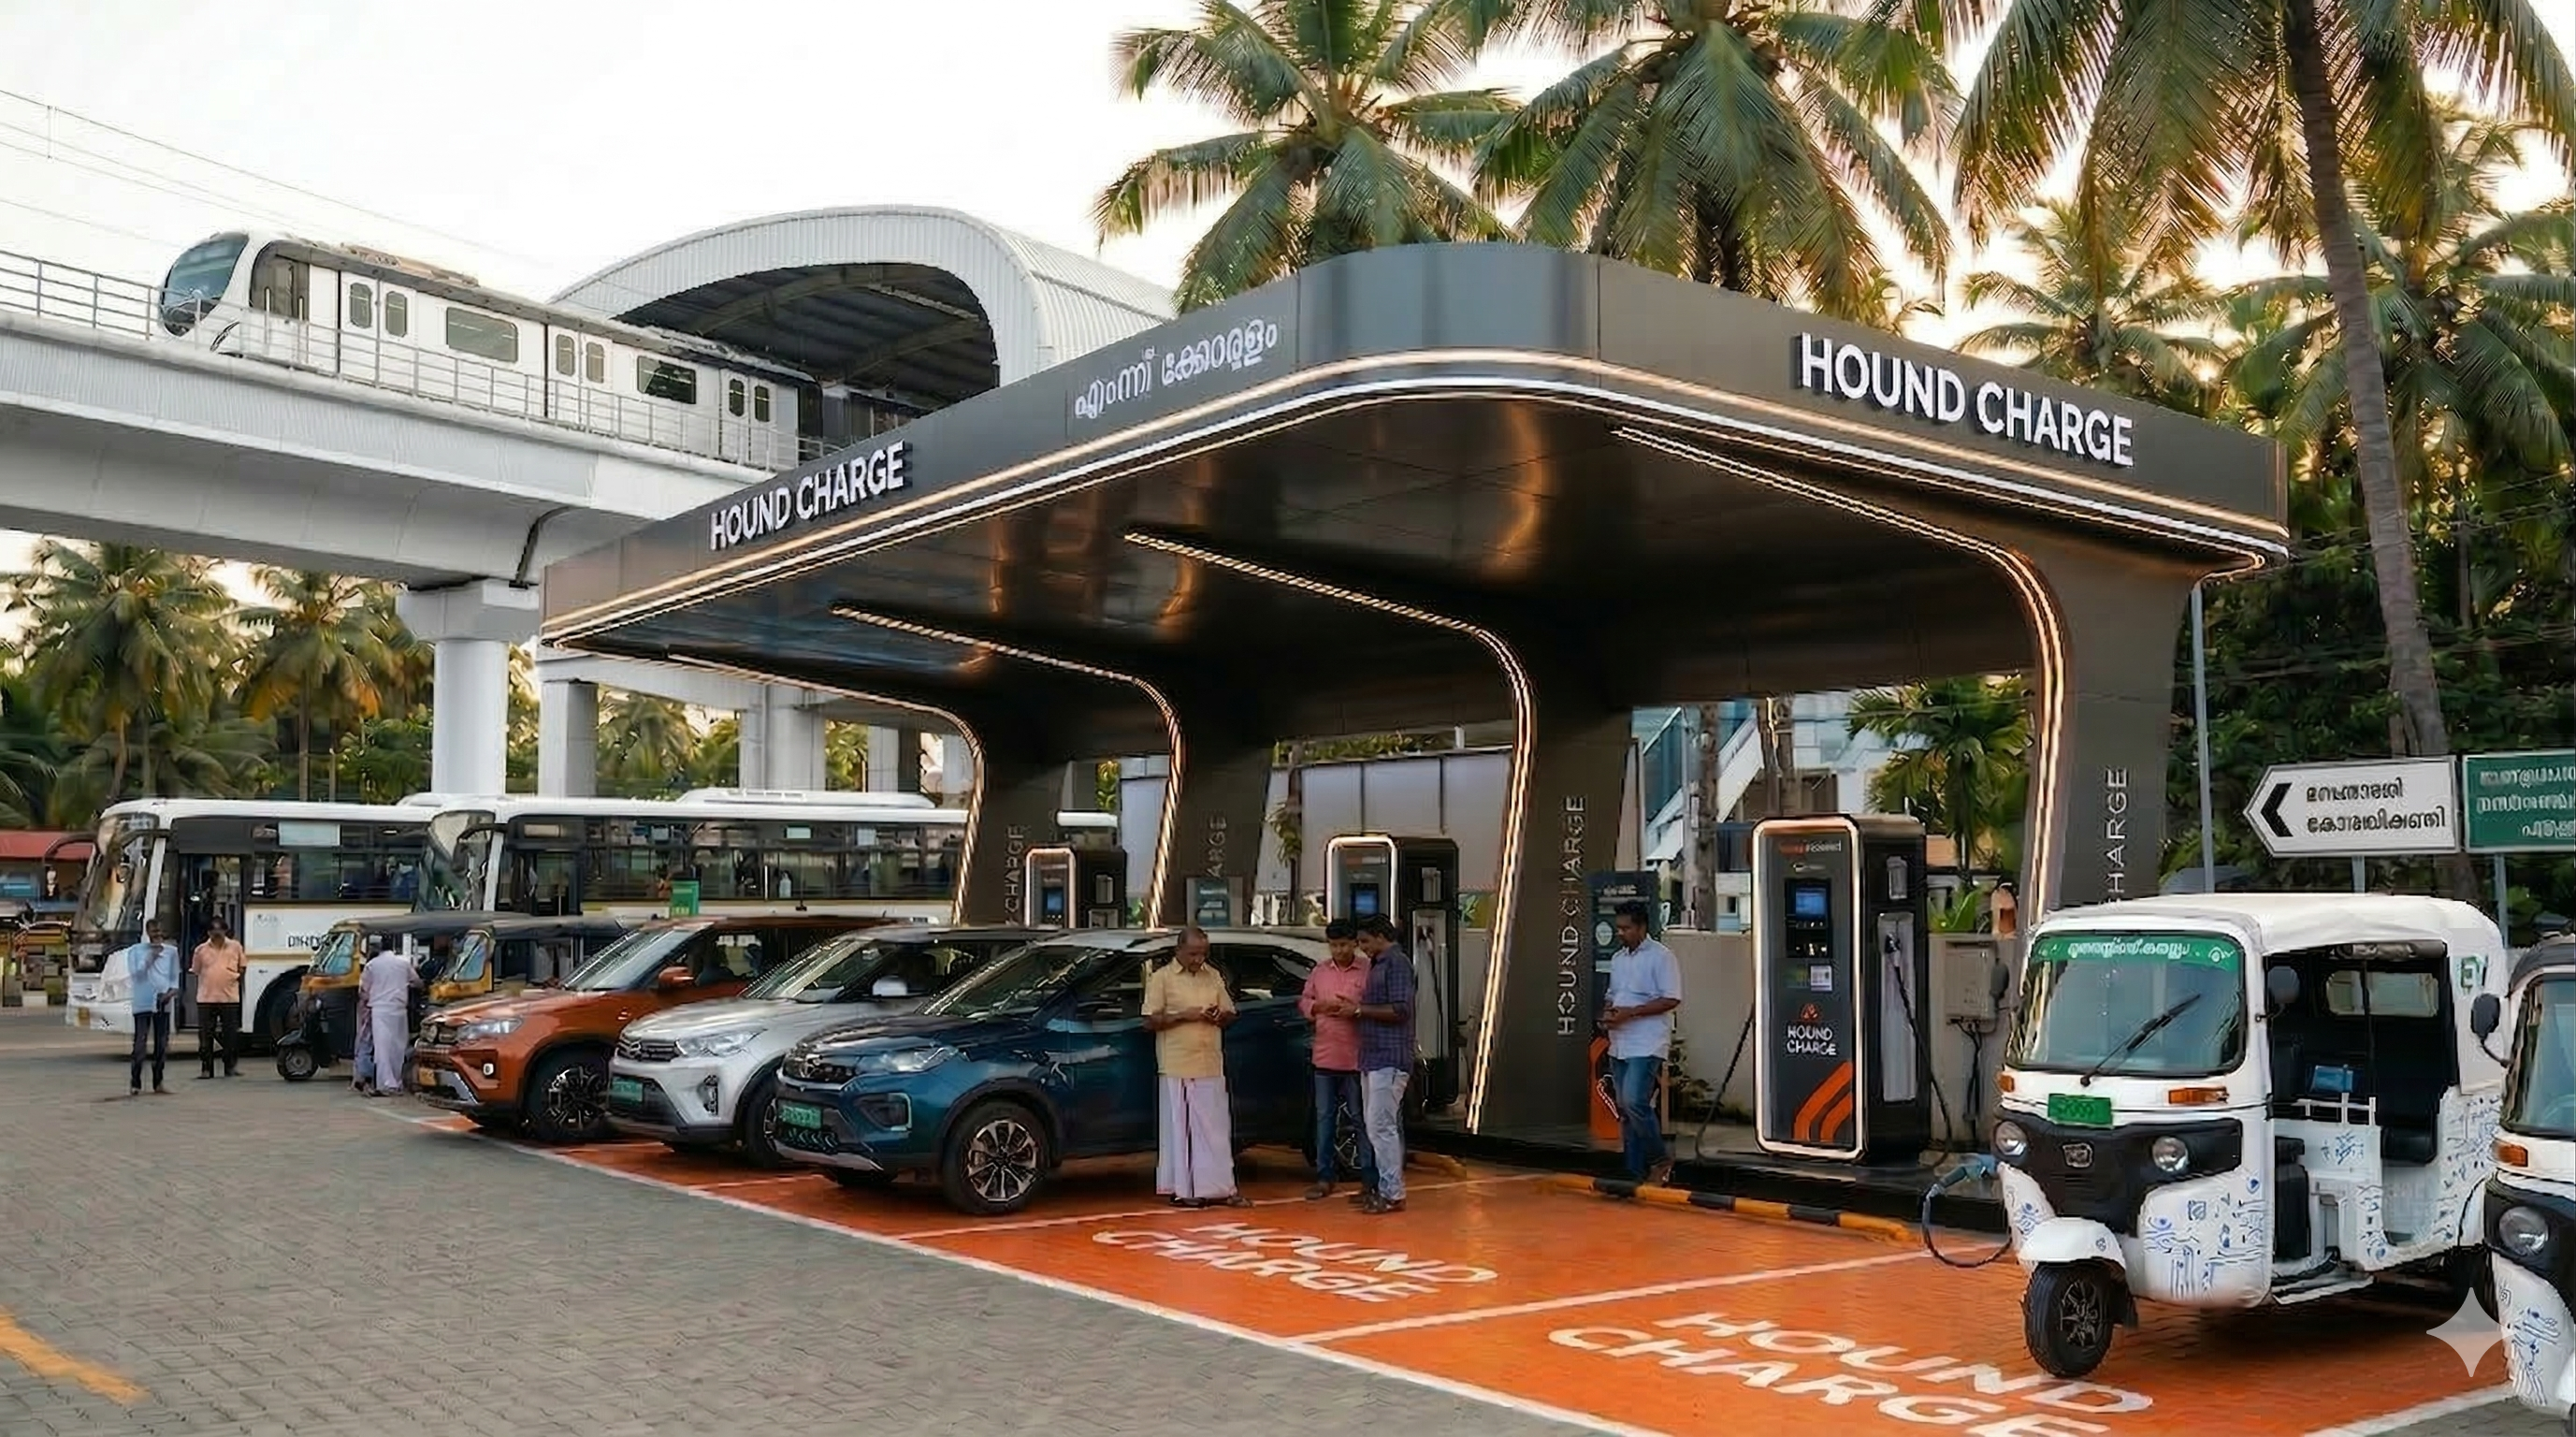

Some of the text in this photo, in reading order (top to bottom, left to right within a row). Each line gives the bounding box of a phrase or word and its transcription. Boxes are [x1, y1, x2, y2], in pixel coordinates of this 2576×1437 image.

[1801, 332, 2135, 466] HOUND CHARGE
[710, 439, 904, 551] HOUND CHARGE
[2106, 768, 2127, 899] HARGE
[1557, 795, 1585, 1036] HOUND CHARGE
[1787, 1024, 1833, 1041] HOUND
[1787, 1039, 1837, 1055] CHARGE
[1092, 1229, 1440, 1302] CHARGE
[1184, 1222, 1498, 1284] HOUND
[1548, 1326, 2110, 1437] CHARGE
[1653, 1312, 2153, 1414] HOUND
